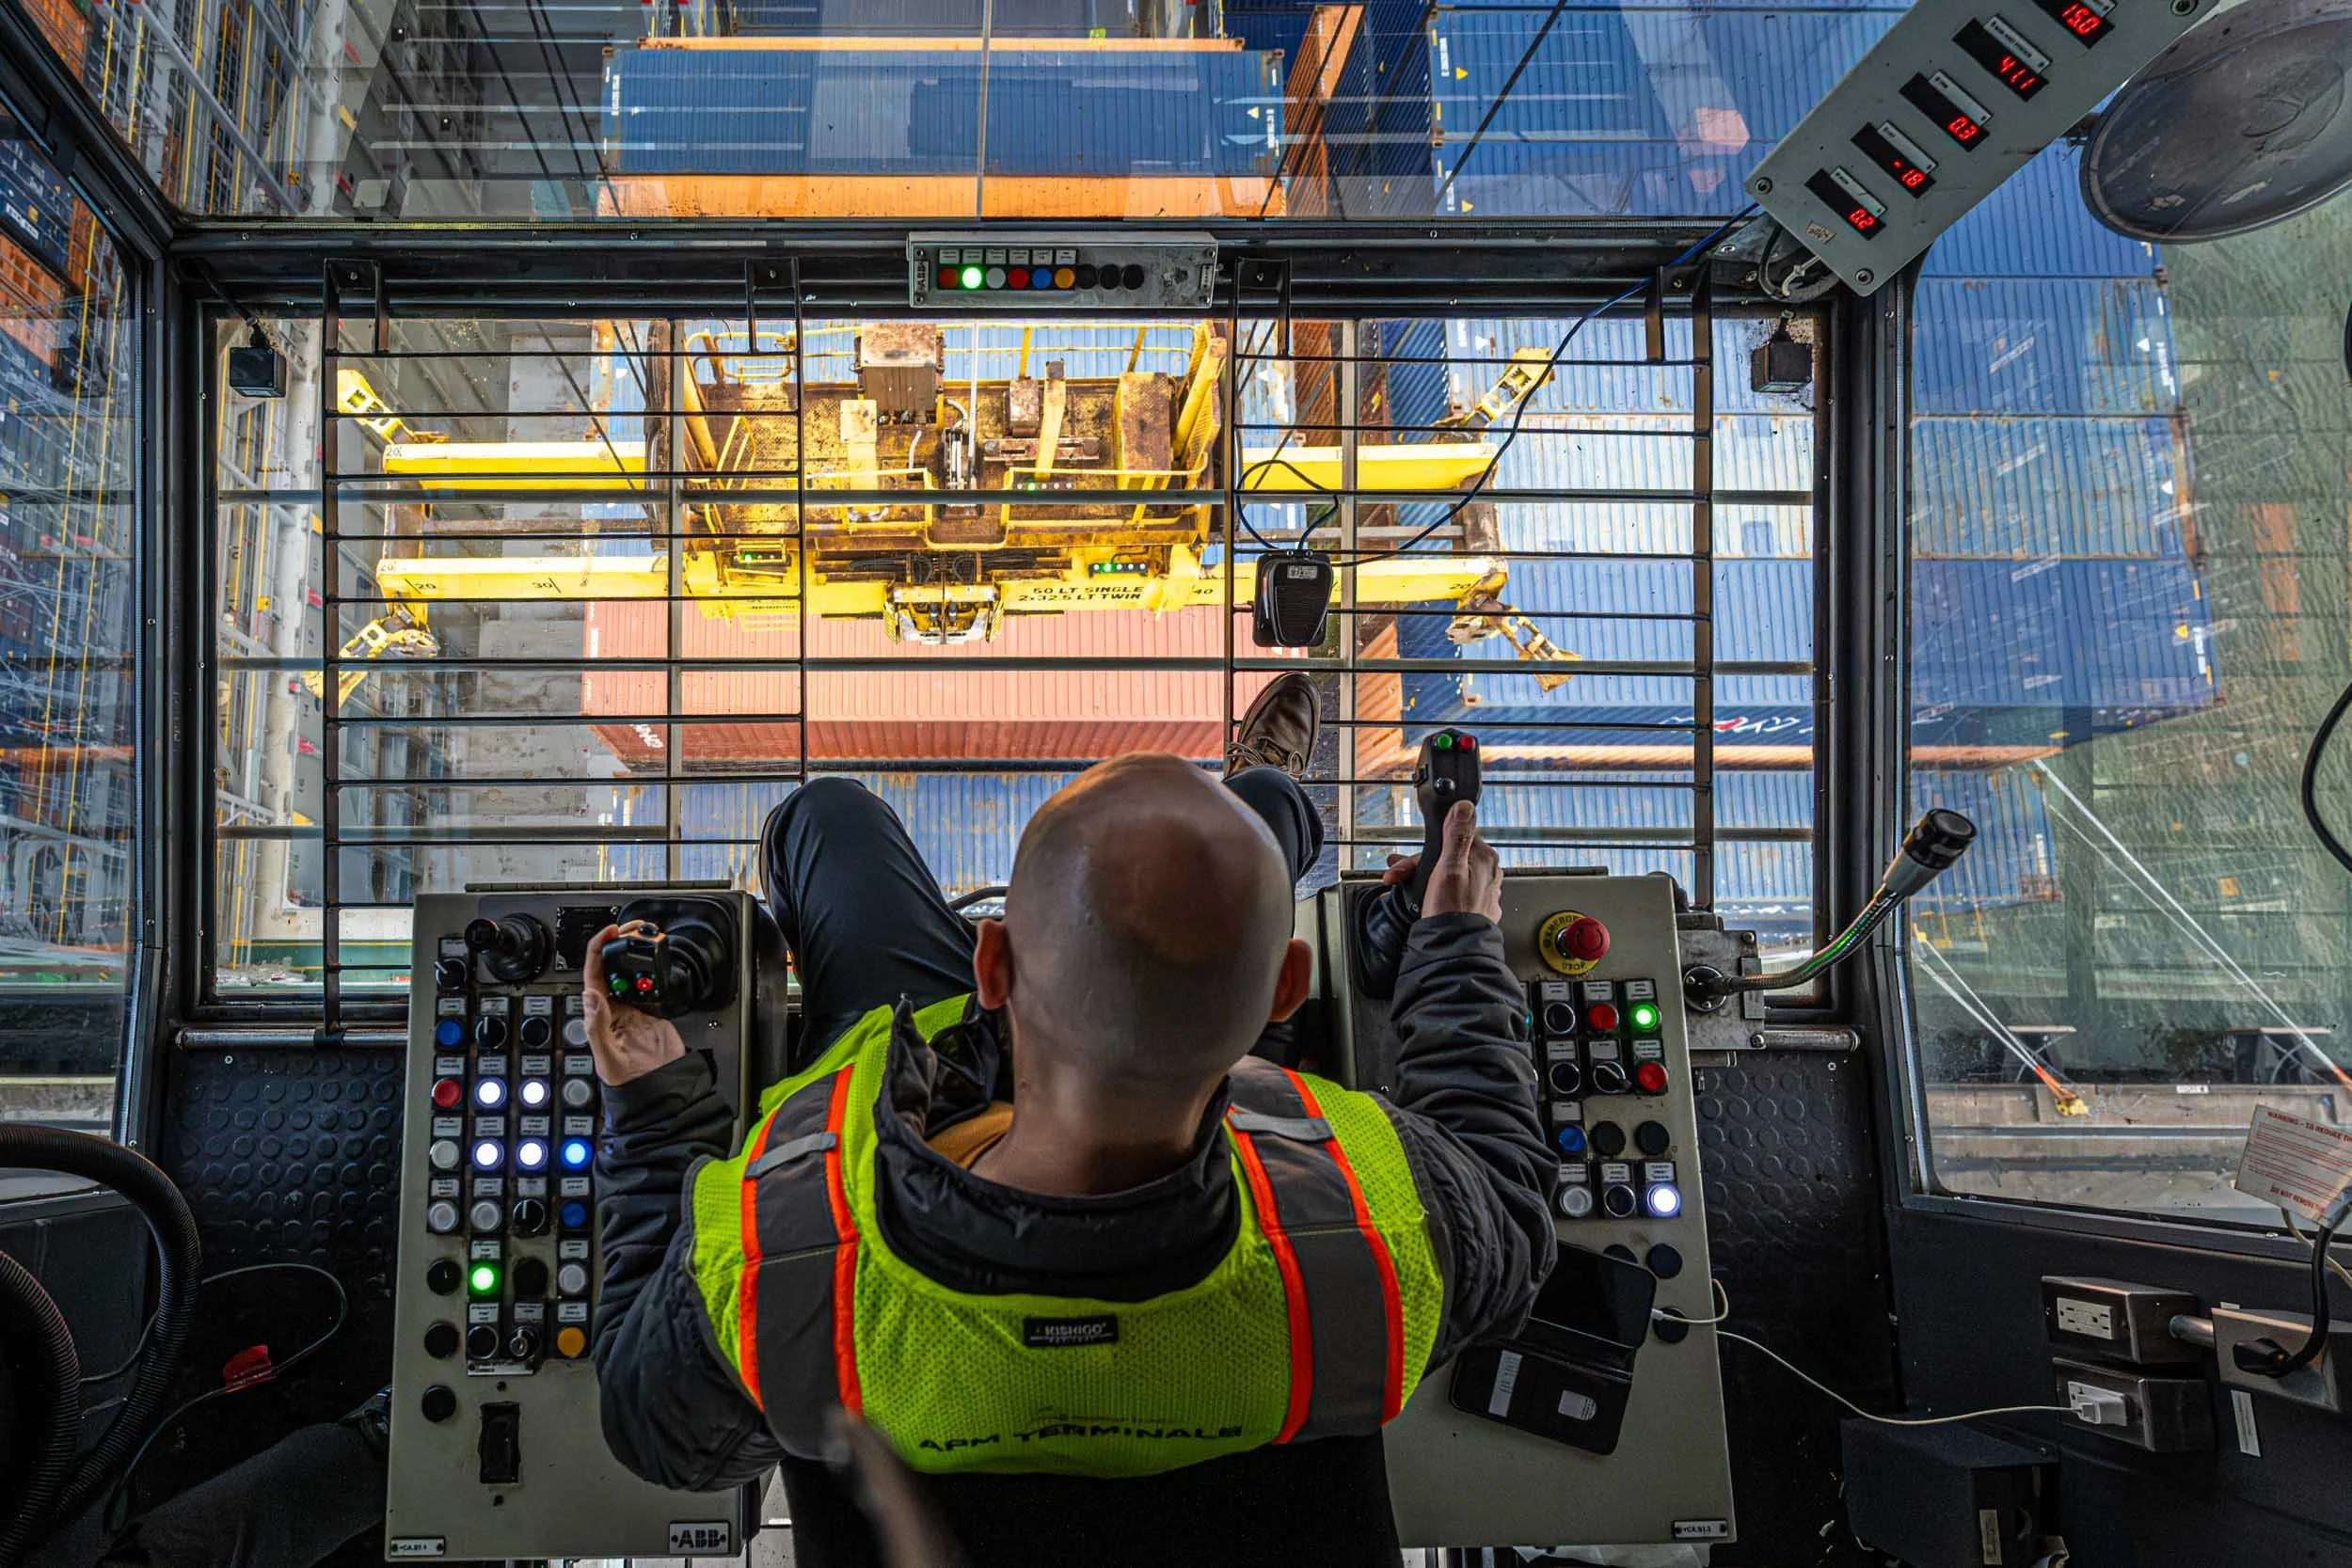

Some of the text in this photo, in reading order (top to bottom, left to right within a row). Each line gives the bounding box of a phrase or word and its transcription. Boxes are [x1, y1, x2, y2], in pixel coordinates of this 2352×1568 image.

[1085, 585, 1144, 594] SINGLE
[2267, 1110, 2299, 1126] WARNING
[2306, 1122, 2315, 1131] TO
[2315, 1124, 2342, 1140] REDUCE
[918, 1422, 1243, 1452] APM TERMINALS
[677, 1528, 721, 1548] ABB
